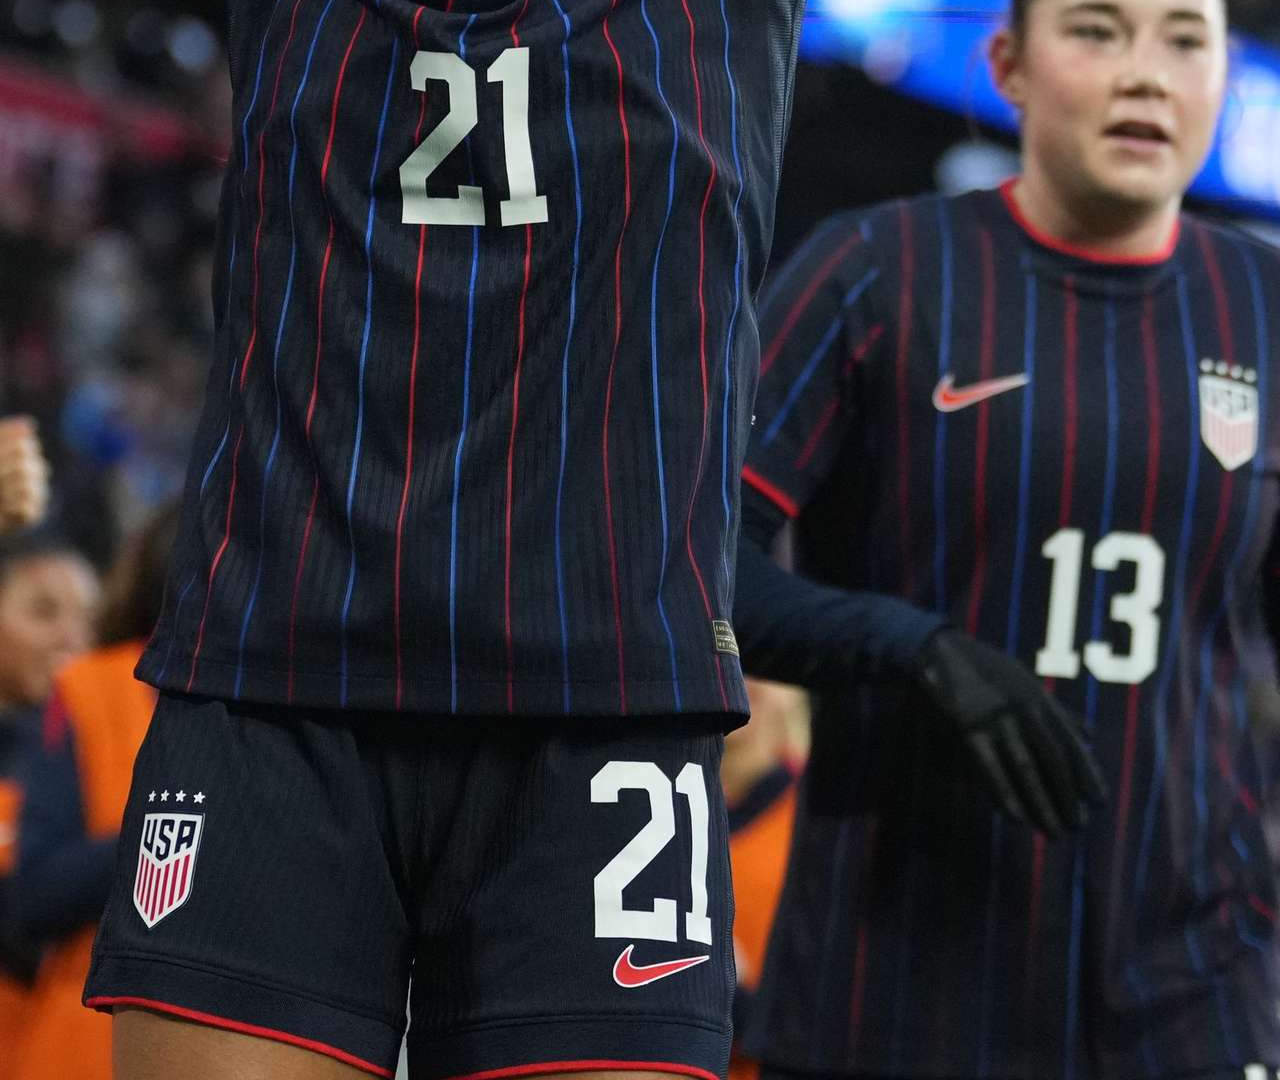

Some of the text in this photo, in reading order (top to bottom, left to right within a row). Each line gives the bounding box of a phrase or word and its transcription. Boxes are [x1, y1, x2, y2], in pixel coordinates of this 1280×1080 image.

[399, 47, 549, 226] 21
[1035, 528, 1166, 684] 13
[143, 818, 197, 862] USA
[590, 760, 713, 946] 21
